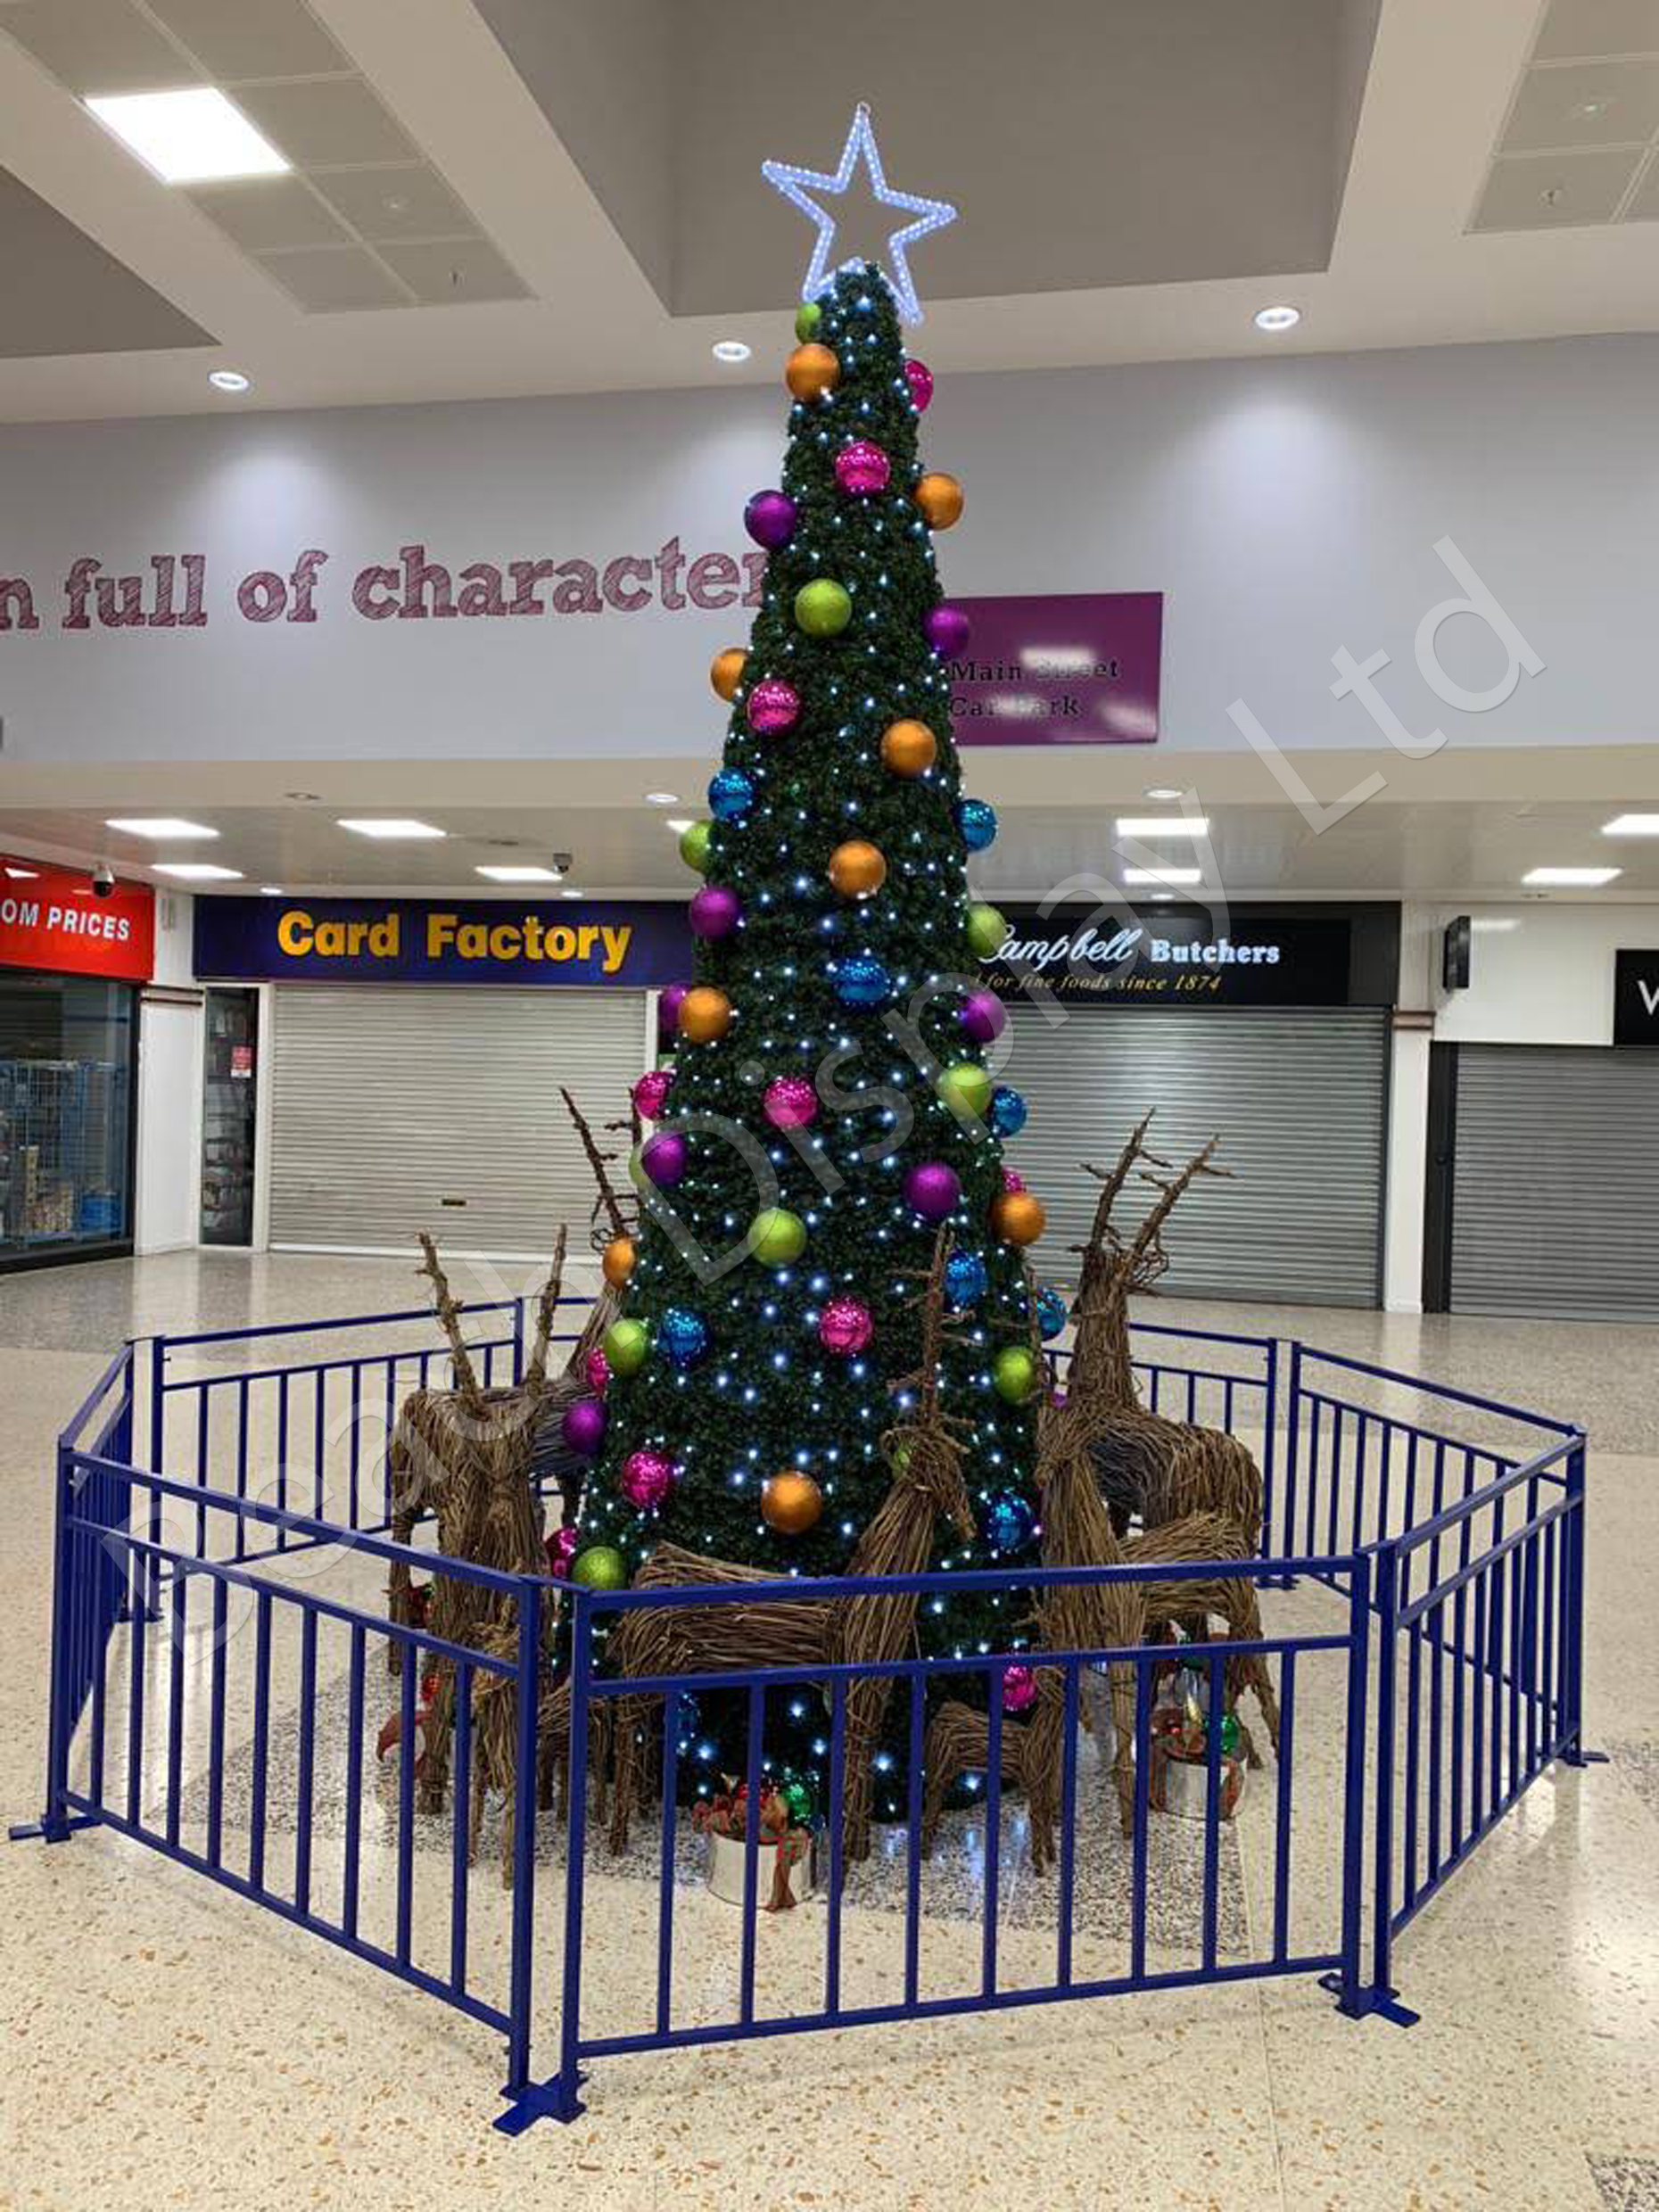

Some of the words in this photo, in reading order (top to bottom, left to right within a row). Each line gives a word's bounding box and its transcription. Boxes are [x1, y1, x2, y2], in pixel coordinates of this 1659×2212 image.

[62, 554, 208, 629] full
[236, 550, 328, 623] of
[951, 660, 1021, 681] Main
[2, 898, 40, 928] OM
[47, 906, 130, 941] PRICES
[277, 910, 400, 957] Card
[426, 914, 632, 973] Factory
[1150, 938, 1280, 964] Butchers
[986, 971, 1013, 989] for
[1016, 972, 1054, 990] fine
[1059, 972, 1110, 990] foods
[1119, 974, 1168, 990] since
[1174, 974, 1222, 991] 1874
